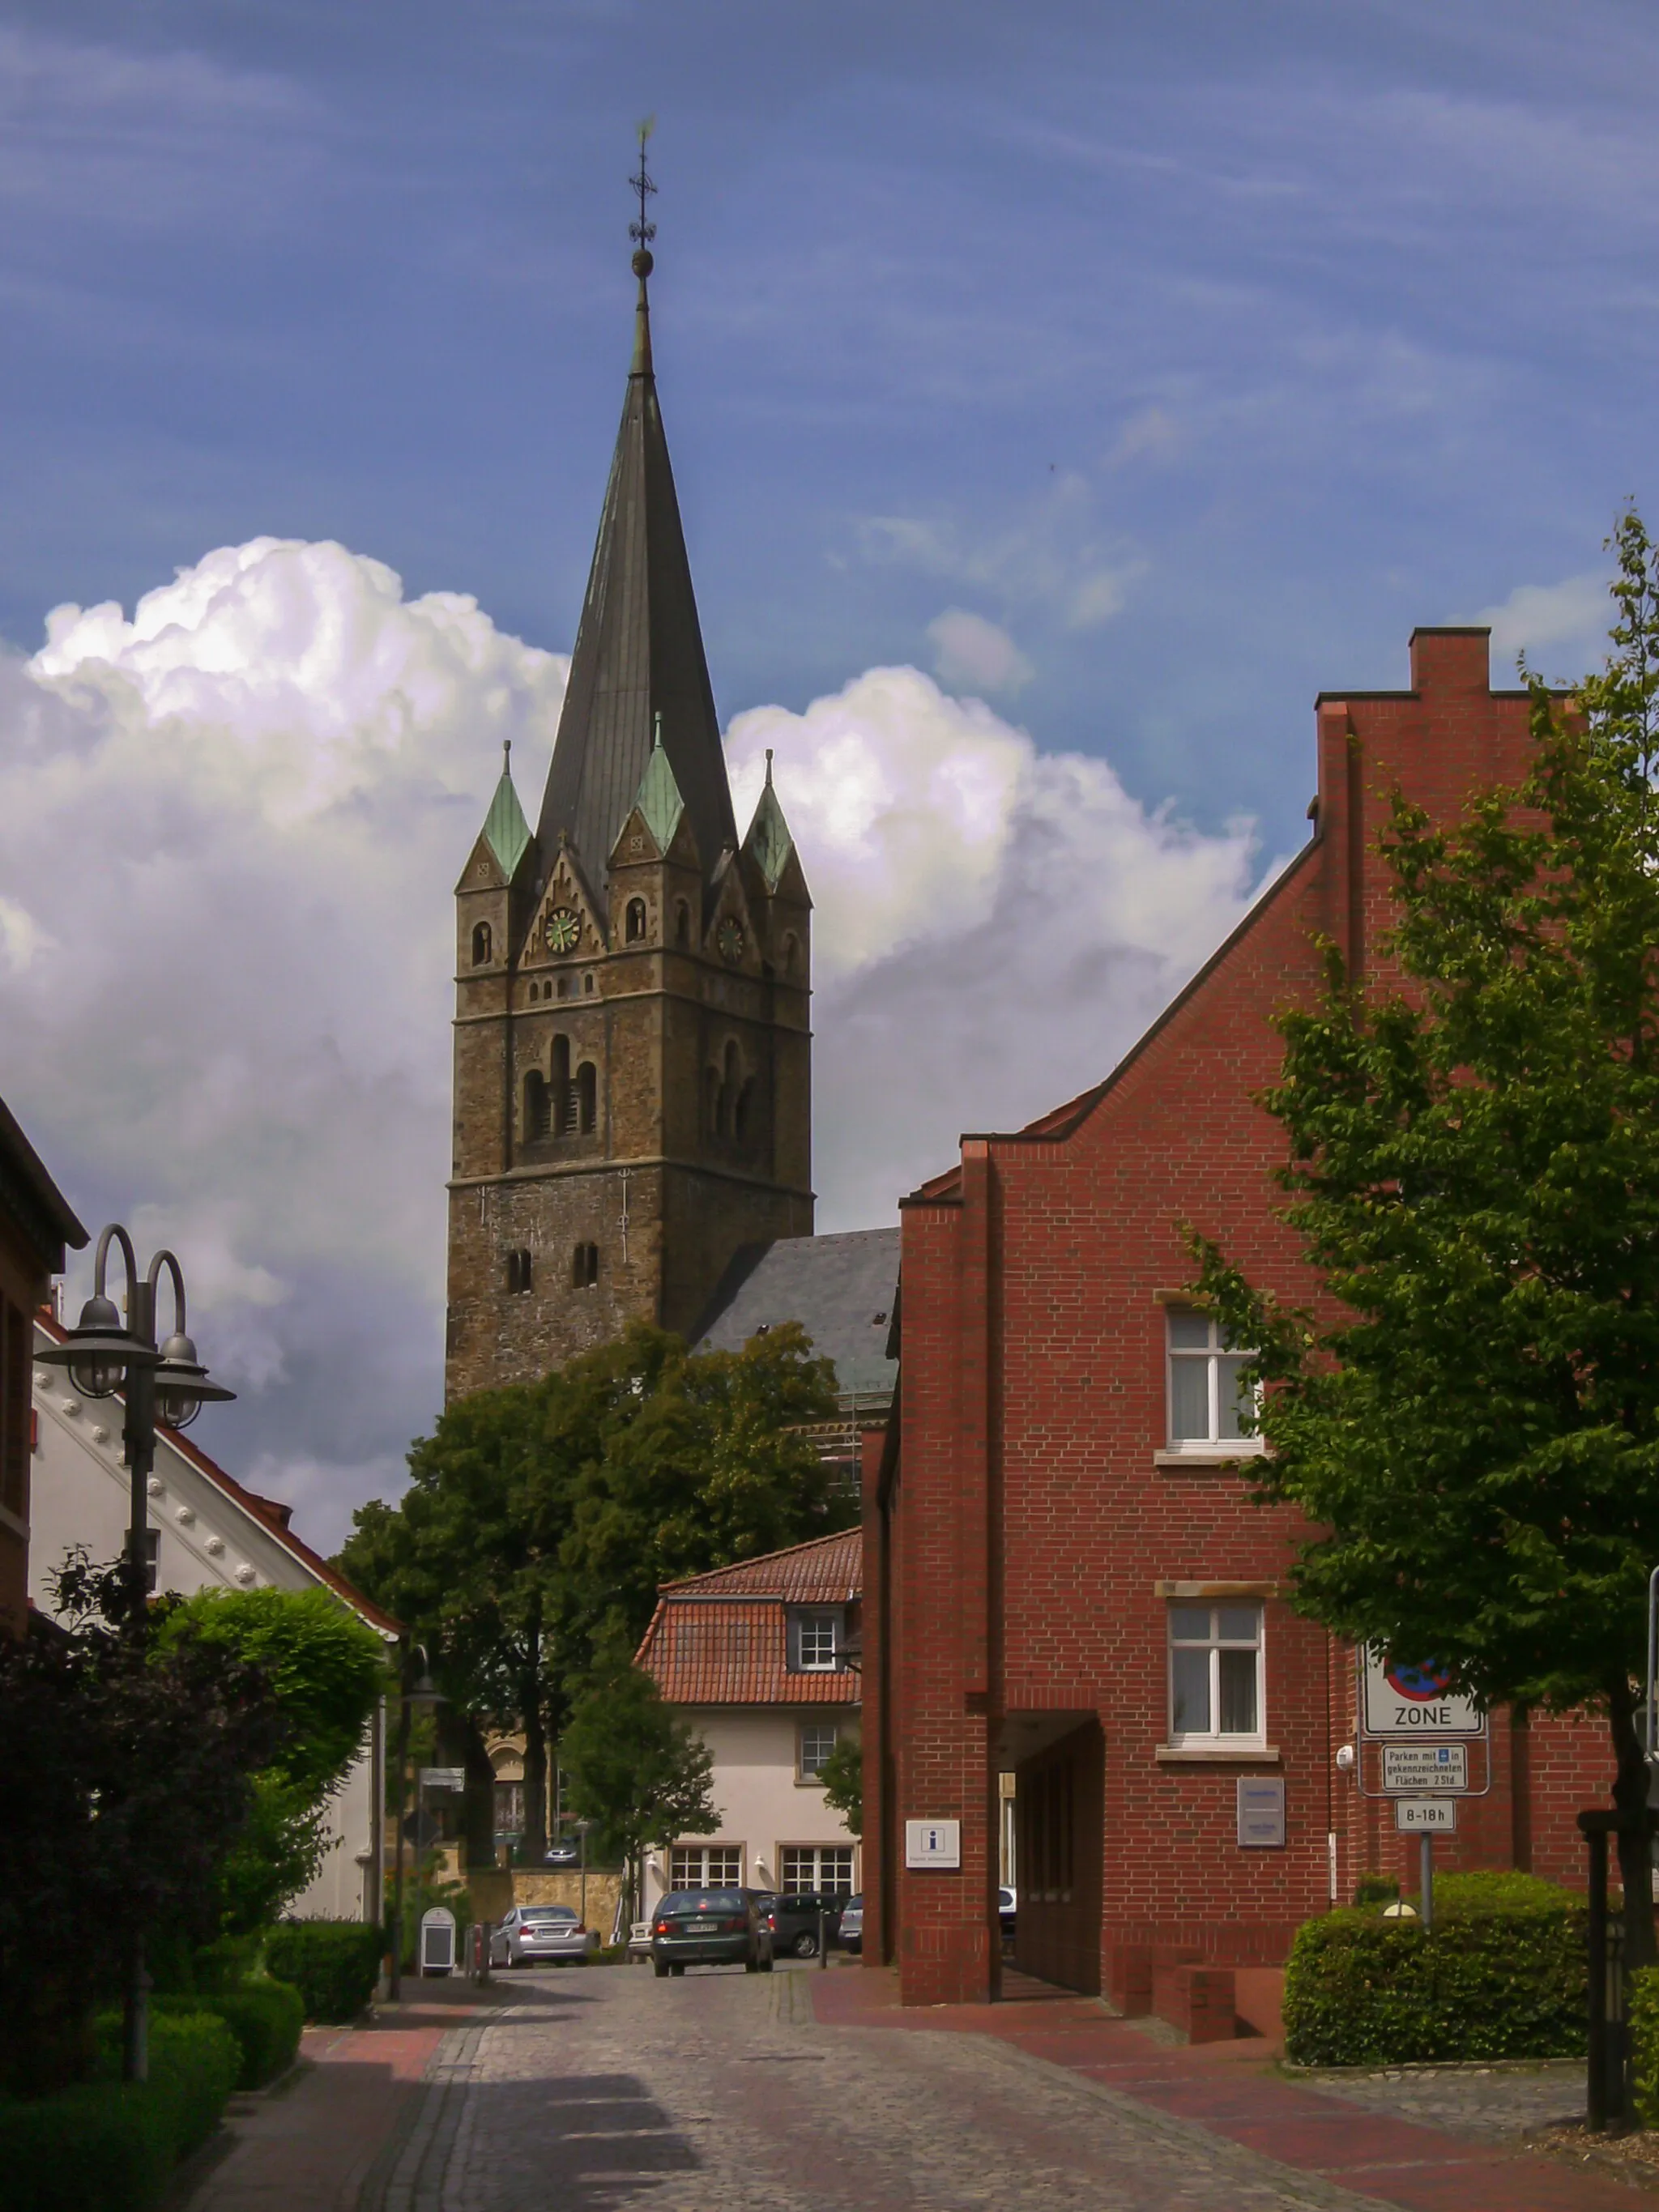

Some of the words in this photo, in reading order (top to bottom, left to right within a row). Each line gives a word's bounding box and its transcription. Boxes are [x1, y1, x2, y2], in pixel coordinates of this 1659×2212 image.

[1395, 1707, 1452, 1724] ZONE
[1389, 1751, 1418, 1761] Parken
[1422, 1751, 1436, 1761] mit
[1451, 1752, 1459, 1761] in
[1387, 1764, 1462, 1775] gekennzeichneten
[1395, 1775, 1427, 1785] Flächen
[1406, 1809, 1436, 1821] 8-18
